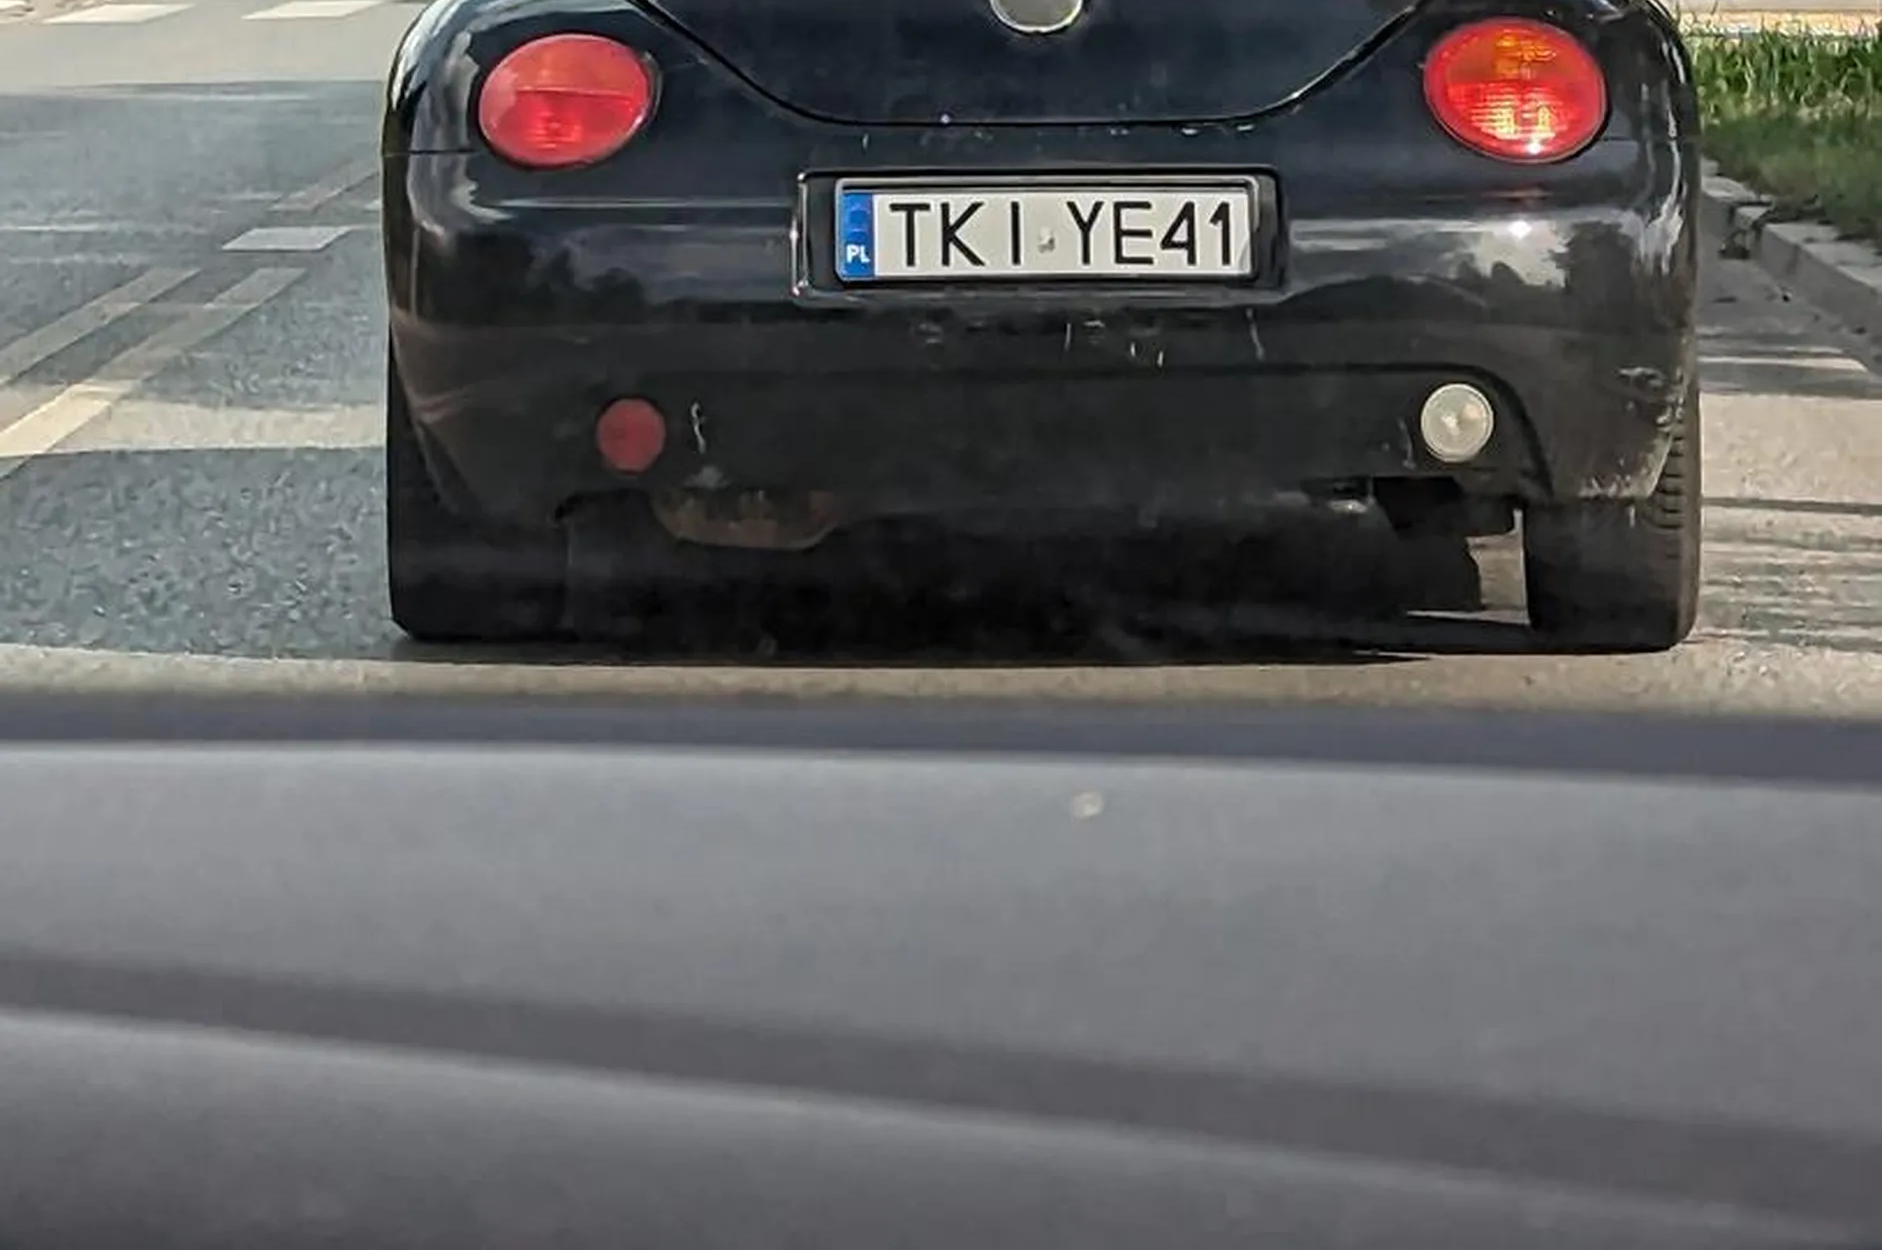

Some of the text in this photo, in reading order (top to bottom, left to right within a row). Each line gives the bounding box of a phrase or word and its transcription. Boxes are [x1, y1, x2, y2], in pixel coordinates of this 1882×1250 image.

[846, 244, 870, 264] PL
[889, 200, 1231, 267] TKI YE41
